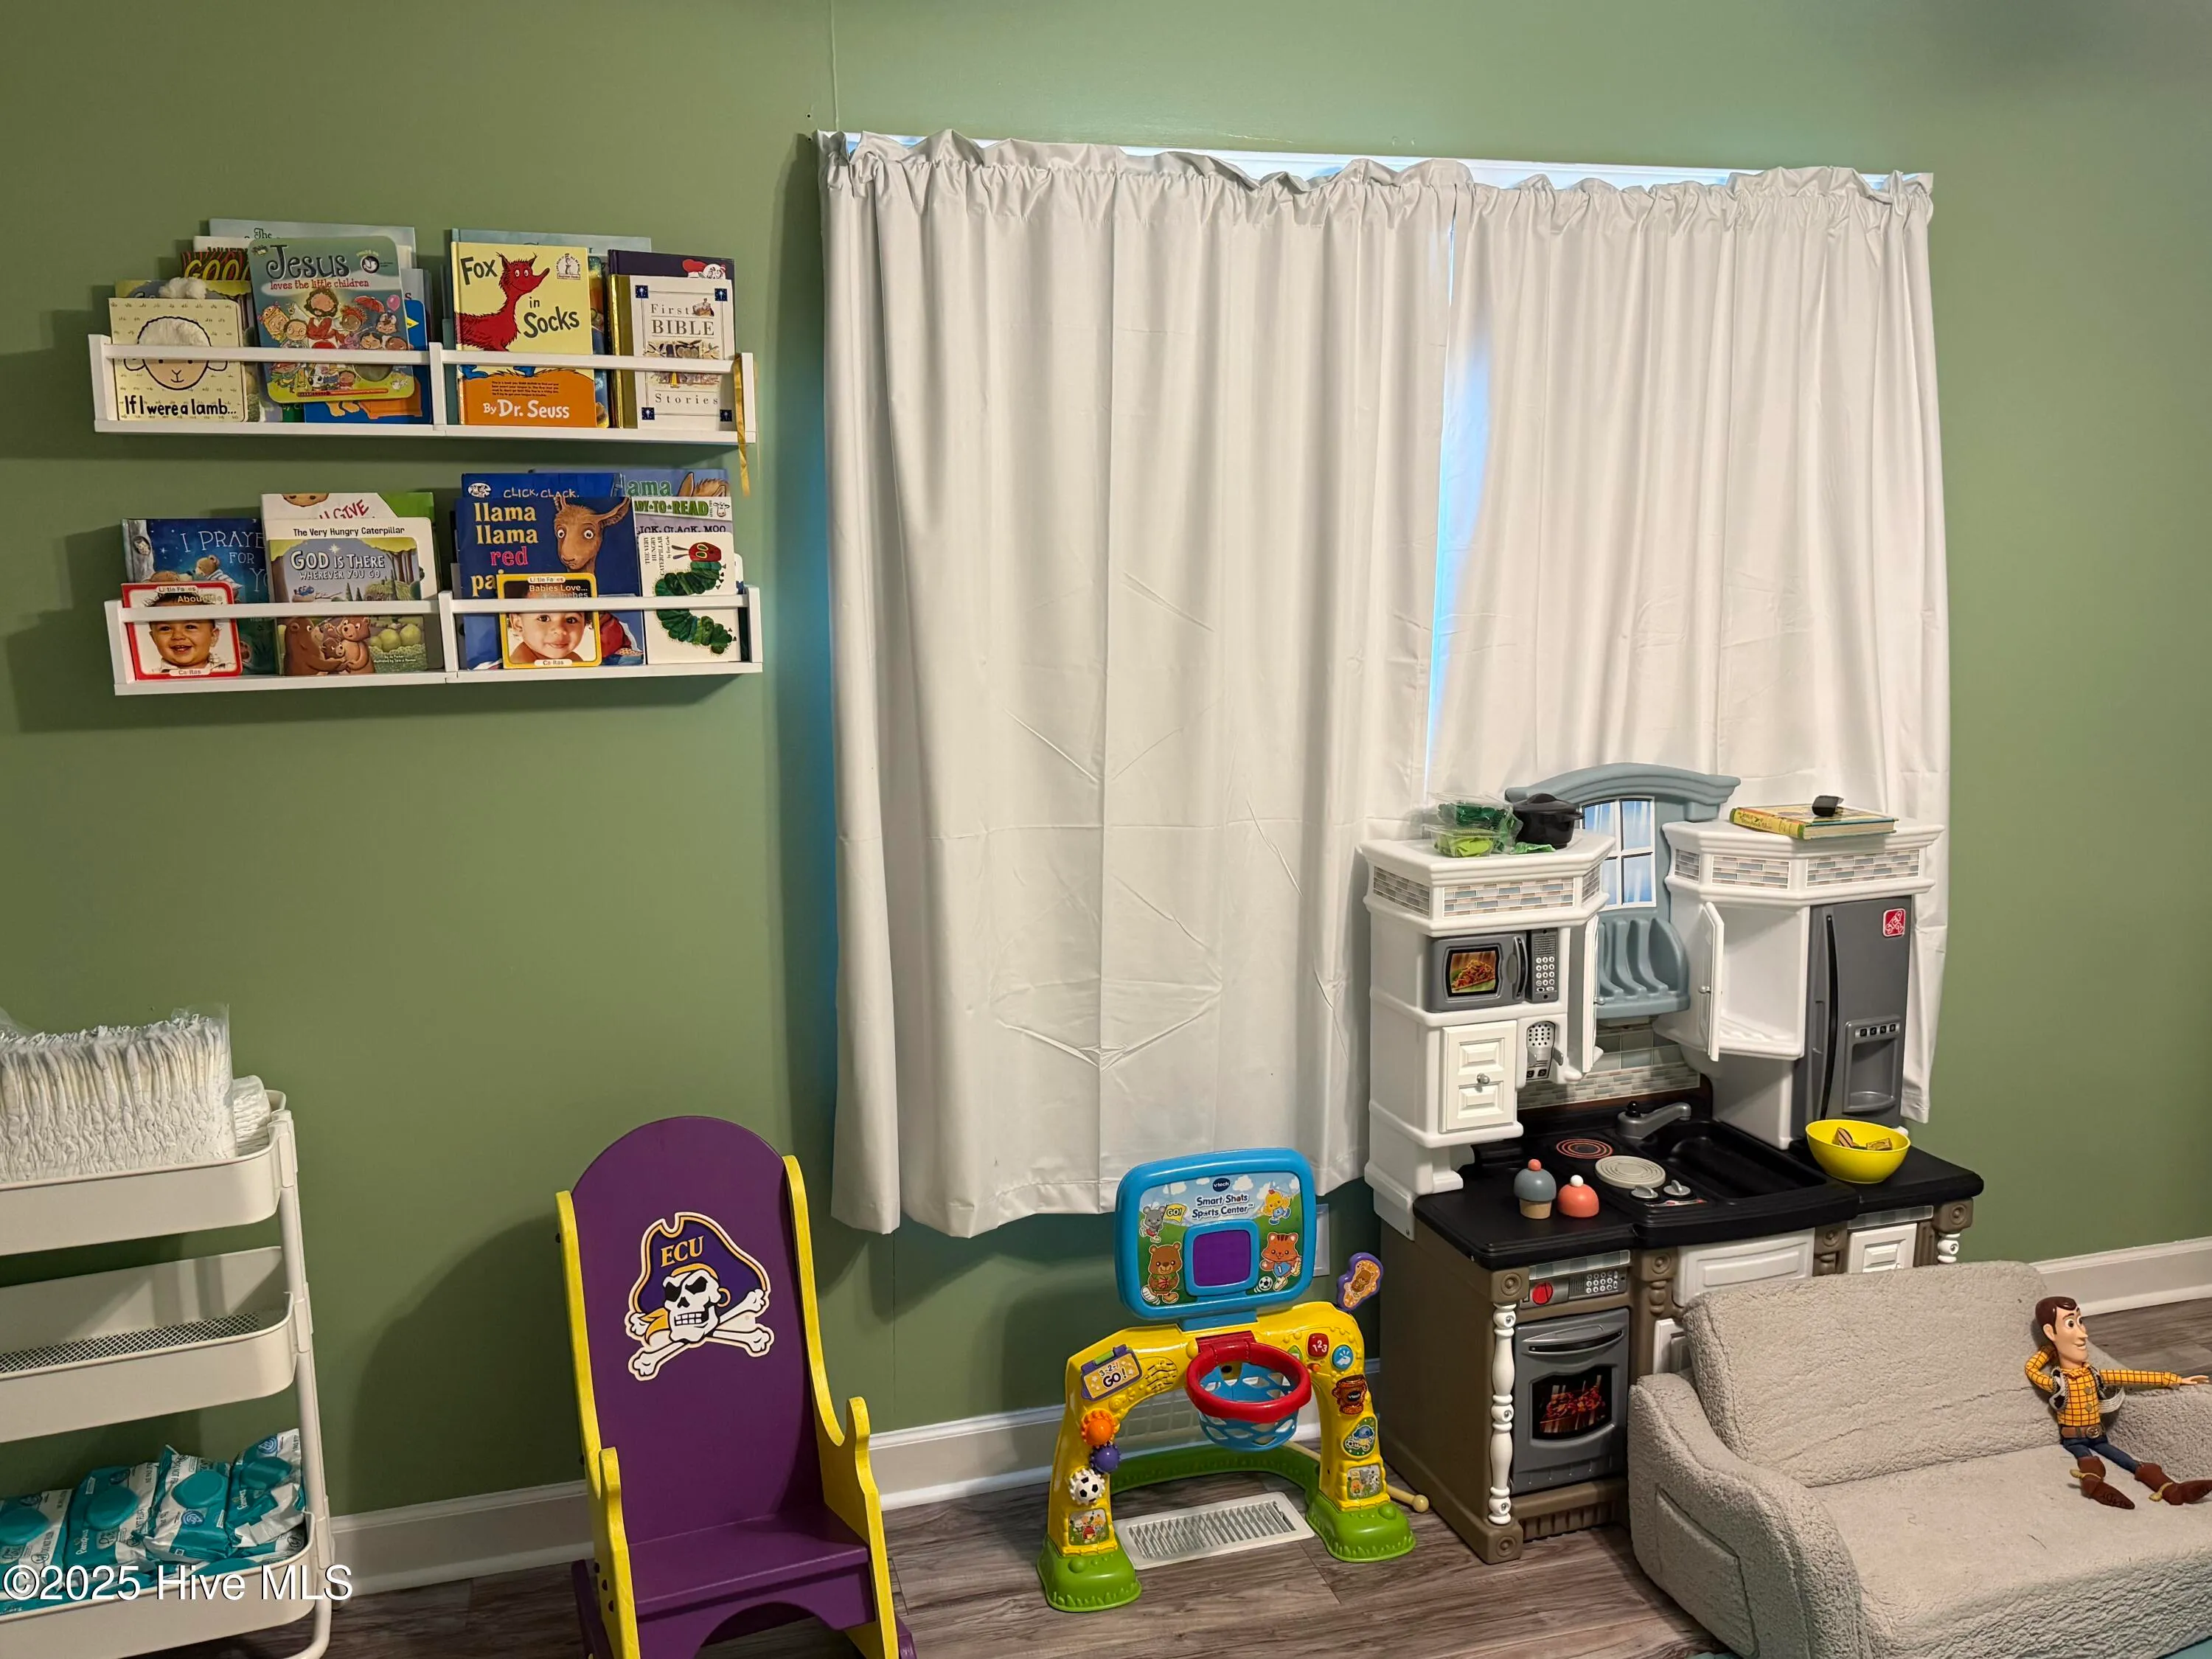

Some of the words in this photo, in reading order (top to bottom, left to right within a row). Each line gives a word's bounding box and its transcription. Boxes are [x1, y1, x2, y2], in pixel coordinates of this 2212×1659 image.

[184, 259, 251, 281] GOO
[266, 244, 351, 280] Jesus
[460, 256, 498, 285] Fox
[270, 280, 293, 290] loves
[295, 279, 308, 289] the
[311, 279, 332, 288] little
[333, 278, 369, 288] children
[529, 296, 540, 308] in
[650, 303, 689, 315] First
[523, 306, 580, 338] Socks
[651, 319, 714, 335] BIBLE
[125, 394, 136, 414] If
[139, 395, 145, 414] I
[147, 404, 178, 416] were
[181, 404, 188, 415] a
[483, 403, 497, 414] By
[497, 399, 524, 417] Dr.
[527, 400, 570, 419] Seuss
[655, 393, 719, 405] Stories
[624, 476, 672, 497] ama
[473, 502, 537, 522] llama
[293, 528, 307, 536] The
[310, 528, 327, 538] Very
[330, 527, 359, 537] Hungry
[361, 526, 405, 535] Caterpillar
[476, 525, 539, 544] llama
[180, 532, 191, 553] I
[229, 552, 254, 564] FOR
[291, 550, 330, 571] GOD
[333, 555, 344, 569] IS
[346, 554, 385, 569] THERE
[490, 546, 529, 566] red
[657, 536, 665, 576] CATERPILLAR
[249, 568, 268, 593] Y
[299, 570, 344, 581] WHEREVER
[347, 570, 365, 580] YOU
[368, 569, 381, 579] GO
[470, 569, 504, 597] pa
[1885, 910, 1902, 934] STEP
[1196, 1196, 1222, 1206] Smart
[1226, 1194, 1248, 1203] Shots
[1166, 1208, 1182, 1217] GO!
[661, 1235, 704, 1267] ECU
[1103, 1368, 1127, 1387] GO!
